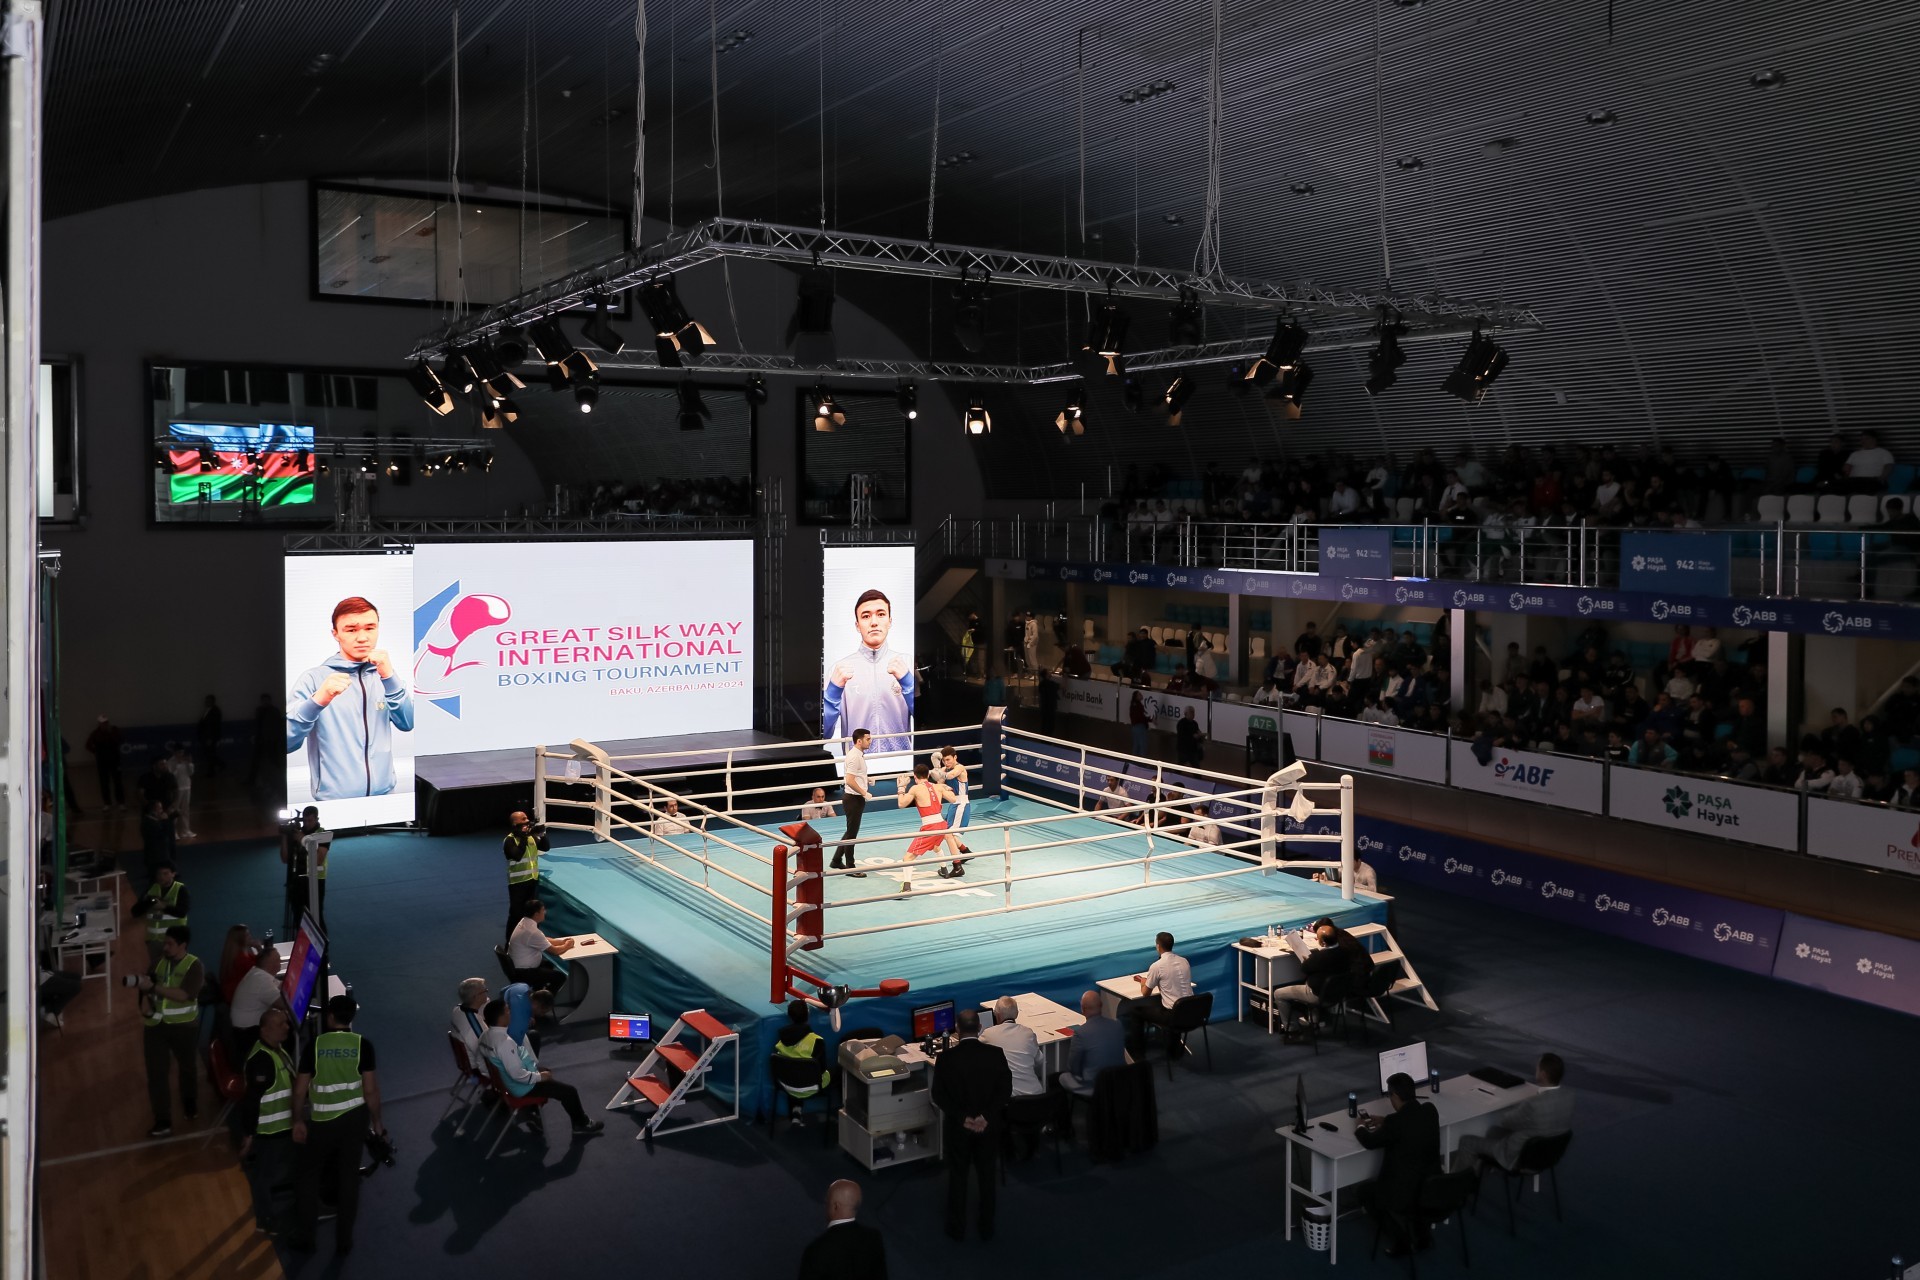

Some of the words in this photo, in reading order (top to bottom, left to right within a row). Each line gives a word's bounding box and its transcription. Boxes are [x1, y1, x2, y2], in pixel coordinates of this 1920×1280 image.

[1676, 560, 1694, 570] 942
[1303, 584, 1317, 592] ABB
[1352, 587, 1368, 595] ABB
[1407, 590, 1424, 599] ABB
[1467, 594, 1484, 602] ABB
[1525, 596, 1543, 605] ABB
[1594, 600, 1614, 610] ABB
[1669, 604, 1691, 615] ABB
[1753, 610, 1777, 622] ABB
[1845, 616, 1872, 628] ABB
[496, 627, 600, 645] GREAT
[607, 624, 672, 641] SILK
[679, 621, 742, 638] WAY
[498, 640, 742, 666] INTERNATIONAL
[498, 670, 587, 686] BOXING
[592, 661, 743, 681] TOURNAMENT
[610, 686, 644, 696] BAKU,
[646, 682, 715, 694] AZERBAIJAN
[1062, 688, 1085, 702] Kapital
[1086, 693, 1103, 704] Bank
[1160, 702, 1180, 718] ABB
[1512, 764, 1554, 787] ABF
[1697, 793, 1732, 810] PAŞA
[1697, 809, 1740, 826] Həyat
[1292, 822, 1304, 830] ABB
[1370, 840, 1384, 850] ABB
[1411, 851, 1426, 861] ABB
[1457, 862, 1474, 873] ABB
[1504, 875, 1522, 885] ABB
[1556, 887, 1574, 898] ABB
[1611, 900, 1630, 912] ABB
[1669, 914, 1690, 926] ABB
[1731, 930, 1754, 943] ABB
[1875, 962, 1892, 972] PAŞA
[1873, 969, 1895, 980] Həyat
[318, 1048, 358, 1058] PRESS
